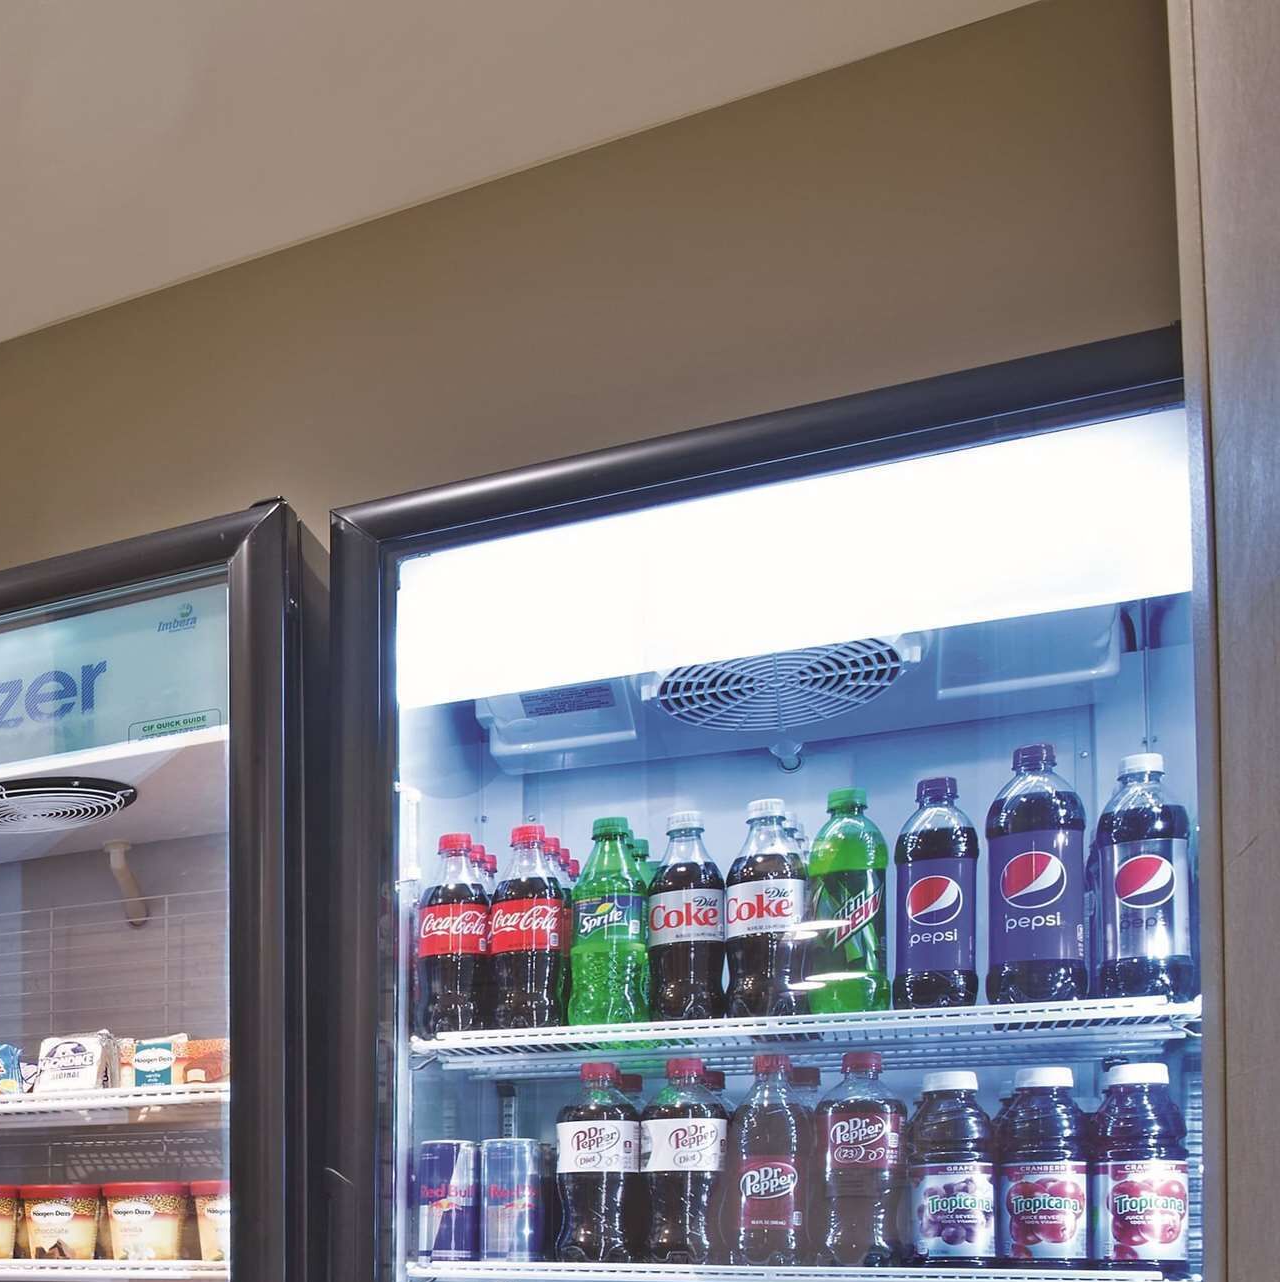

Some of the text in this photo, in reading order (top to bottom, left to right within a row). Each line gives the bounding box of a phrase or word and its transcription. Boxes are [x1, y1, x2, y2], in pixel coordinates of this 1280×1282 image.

[156, 720, 180, 729] QUICK
[183, 715, 207, 724] GUIDE
[694, 897, 718, 907] Diet
[726, 895, 792, 924] Coke
[581, 908, 623, 934] Sprite
[650, 902, 718, 931] Coke
[1005, 912, 1061, 933] pepsi
[909, 929, 958, 947] pepsi
[589, 1126, 605, 1138] Dr
[687, 1125, 704, 1137] Dr
[835, 1120, 883, 1144] Pepper
[849, 1117, 868, 1133] Dr
[571, 1128, 619, 1151] Pepper
[669, 1128, 717, 1151] Pepper
[579, 1153, 596, 1165] Diet
[678, 1153, 697, 1164] Diet
[743, 1170, 796, 1195] Pepper
[760, 1166, 781, 1182] Dr
[929, 1196, 991, 1213] Tropicana
[1013, 1195, 1078, 1212] Tropicana
[1115, 1195, 1184, 1212] Tropicana
